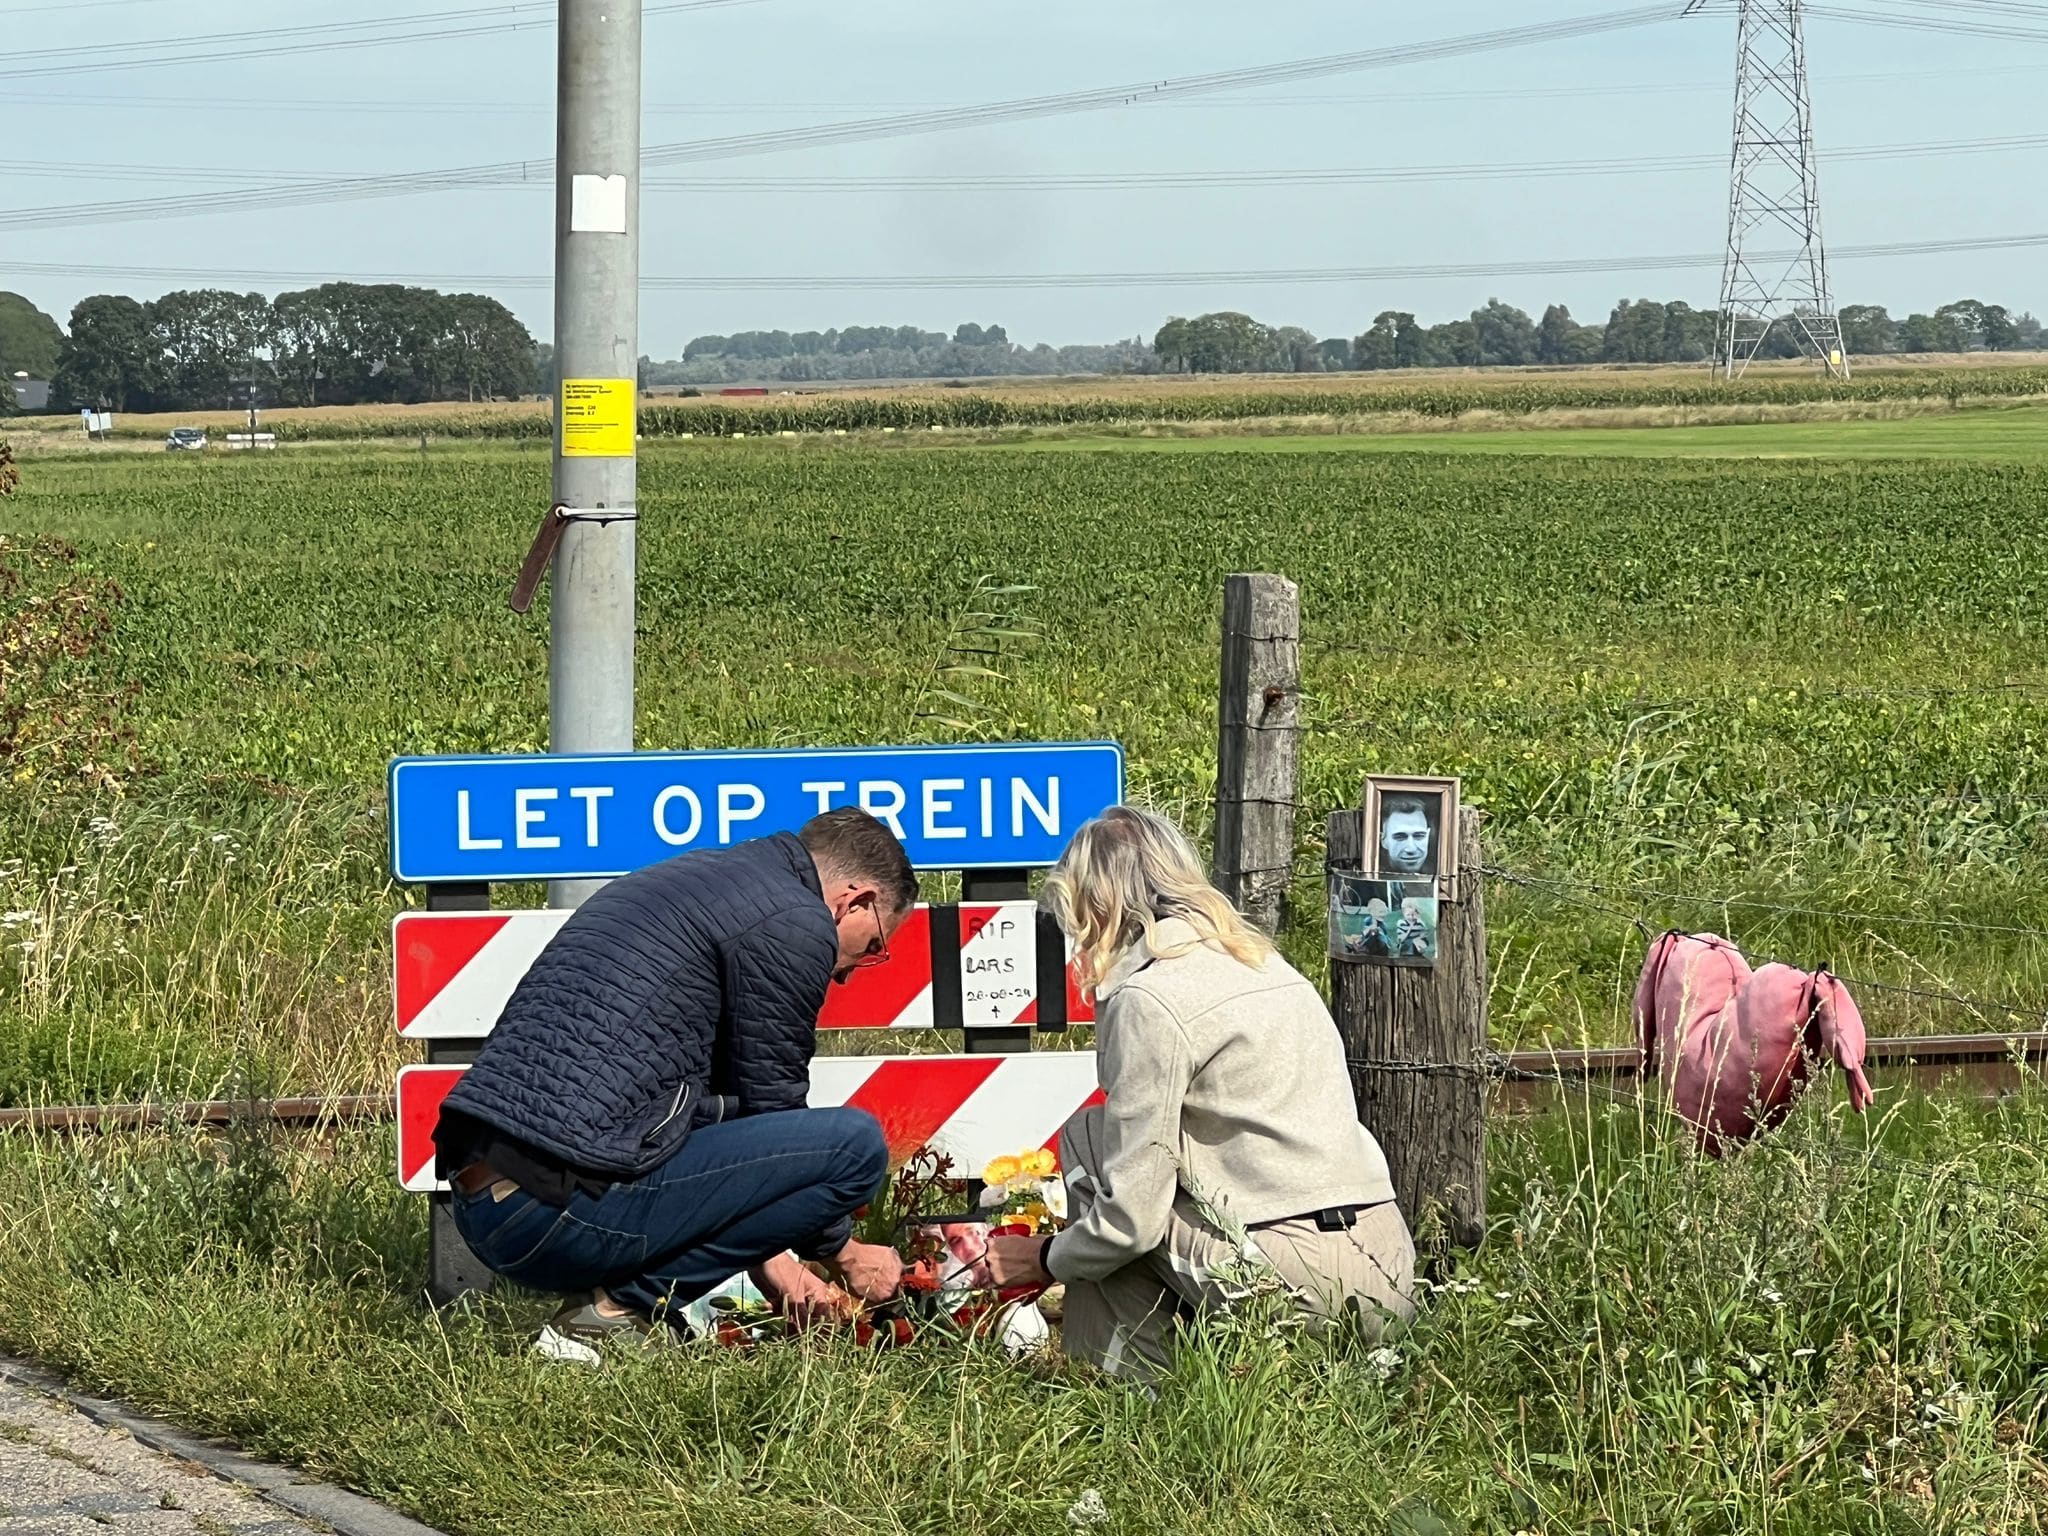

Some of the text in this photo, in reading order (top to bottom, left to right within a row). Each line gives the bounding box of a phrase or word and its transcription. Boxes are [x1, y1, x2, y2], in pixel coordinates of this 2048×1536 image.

[458, 776, 1060, 850] LET OP TREIN
[968, 917, 1014, 939] RIP
[966, 957, 1015, 974] LARS
